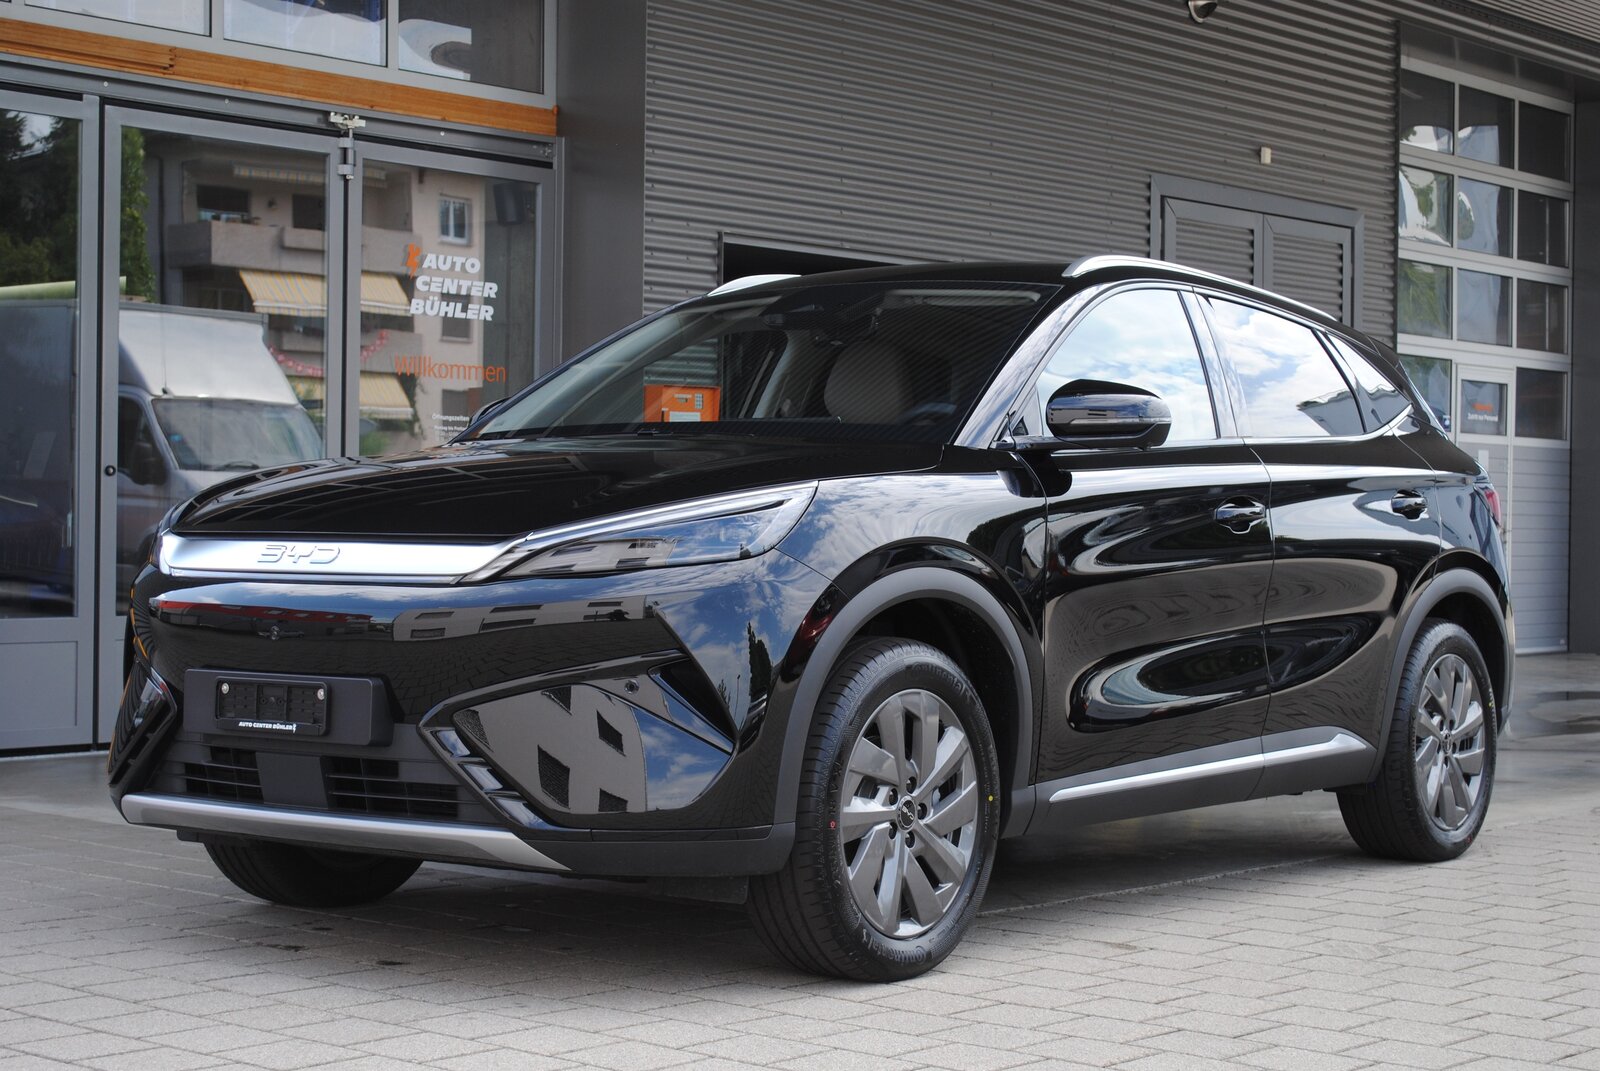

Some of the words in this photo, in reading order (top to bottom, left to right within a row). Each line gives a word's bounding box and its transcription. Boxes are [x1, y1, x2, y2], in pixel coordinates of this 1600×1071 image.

[422, 253, 481, 274] AUTO
[415, 275, 498, 298] CENTER
[409, 296, 494, 321] BÜHLER
[394, 354, 506, 383] Willkommen
[257, 544, 341, 565] BYD
[273, 723, 293, 731] BÜHLER
